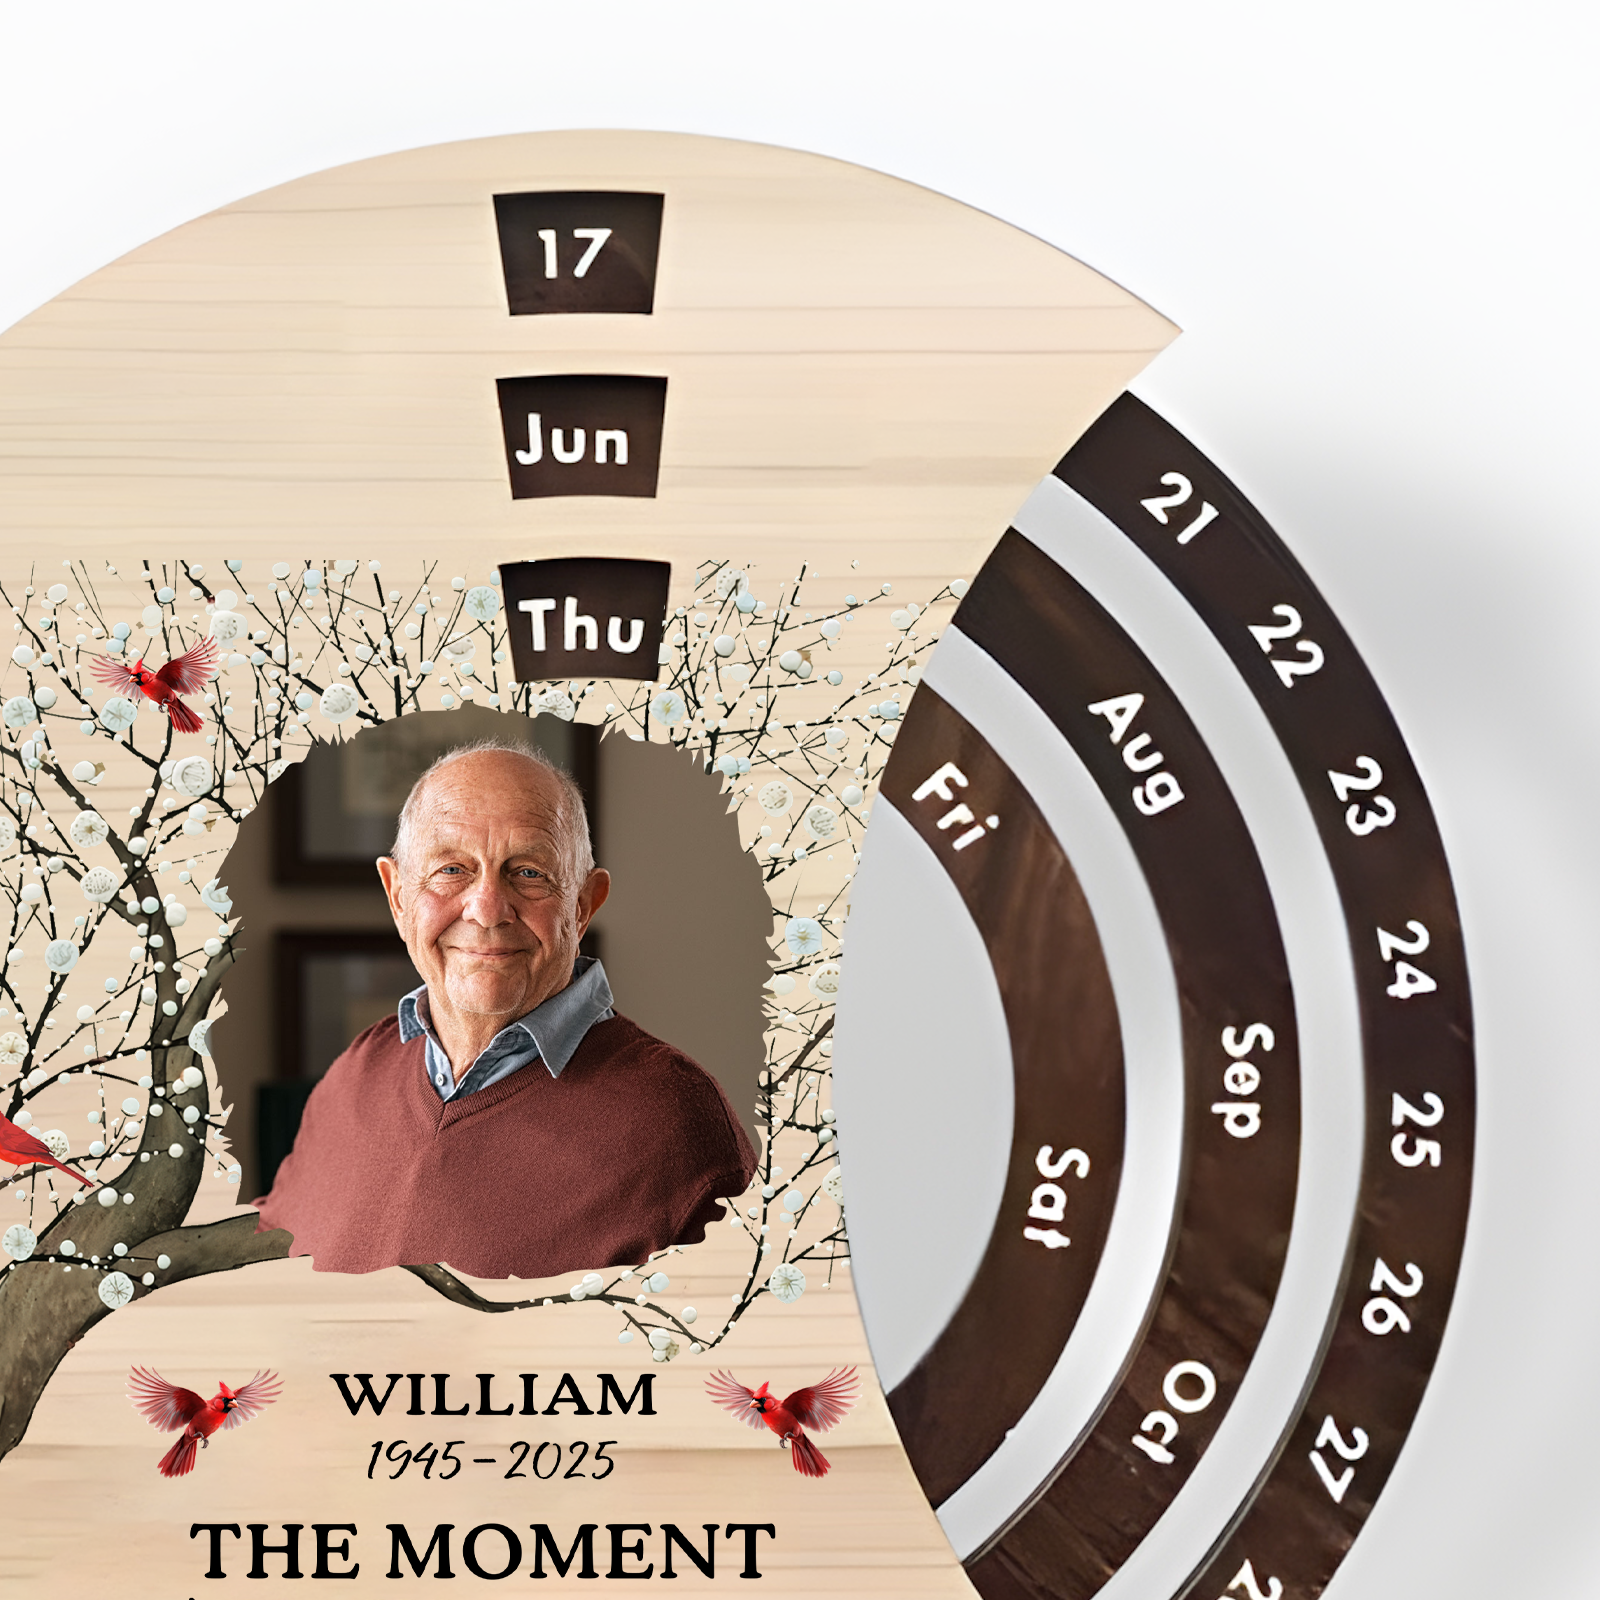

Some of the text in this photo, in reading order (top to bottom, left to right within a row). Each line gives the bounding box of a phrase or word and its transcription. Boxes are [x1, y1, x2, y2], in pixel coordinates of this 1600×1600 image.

[539, 229, 612, 278] 17
[516, 413, 627, 464] Jun
[1141, 472, 1219, 544] 21
[519, 597, 644, 653] Thu
[1249, 605, 1324, 688] 22
[1328, 756, 1396, 835] 23
[1377, 921, 1436, 998] 24
[911, 762, 1090, 1248] Fri Sat
[1088, 693, 1274, 1464] Aug Sep Oct
[1391, 1092, 1444, 1166] 25
[1362, 1258, 1423, 1334] 26
[330, 1373, 657, 1415] WILLIAM
[1310, 1416, 1368, 1502] 27
[190, 1524, 775, 1580] THE MOMENT
